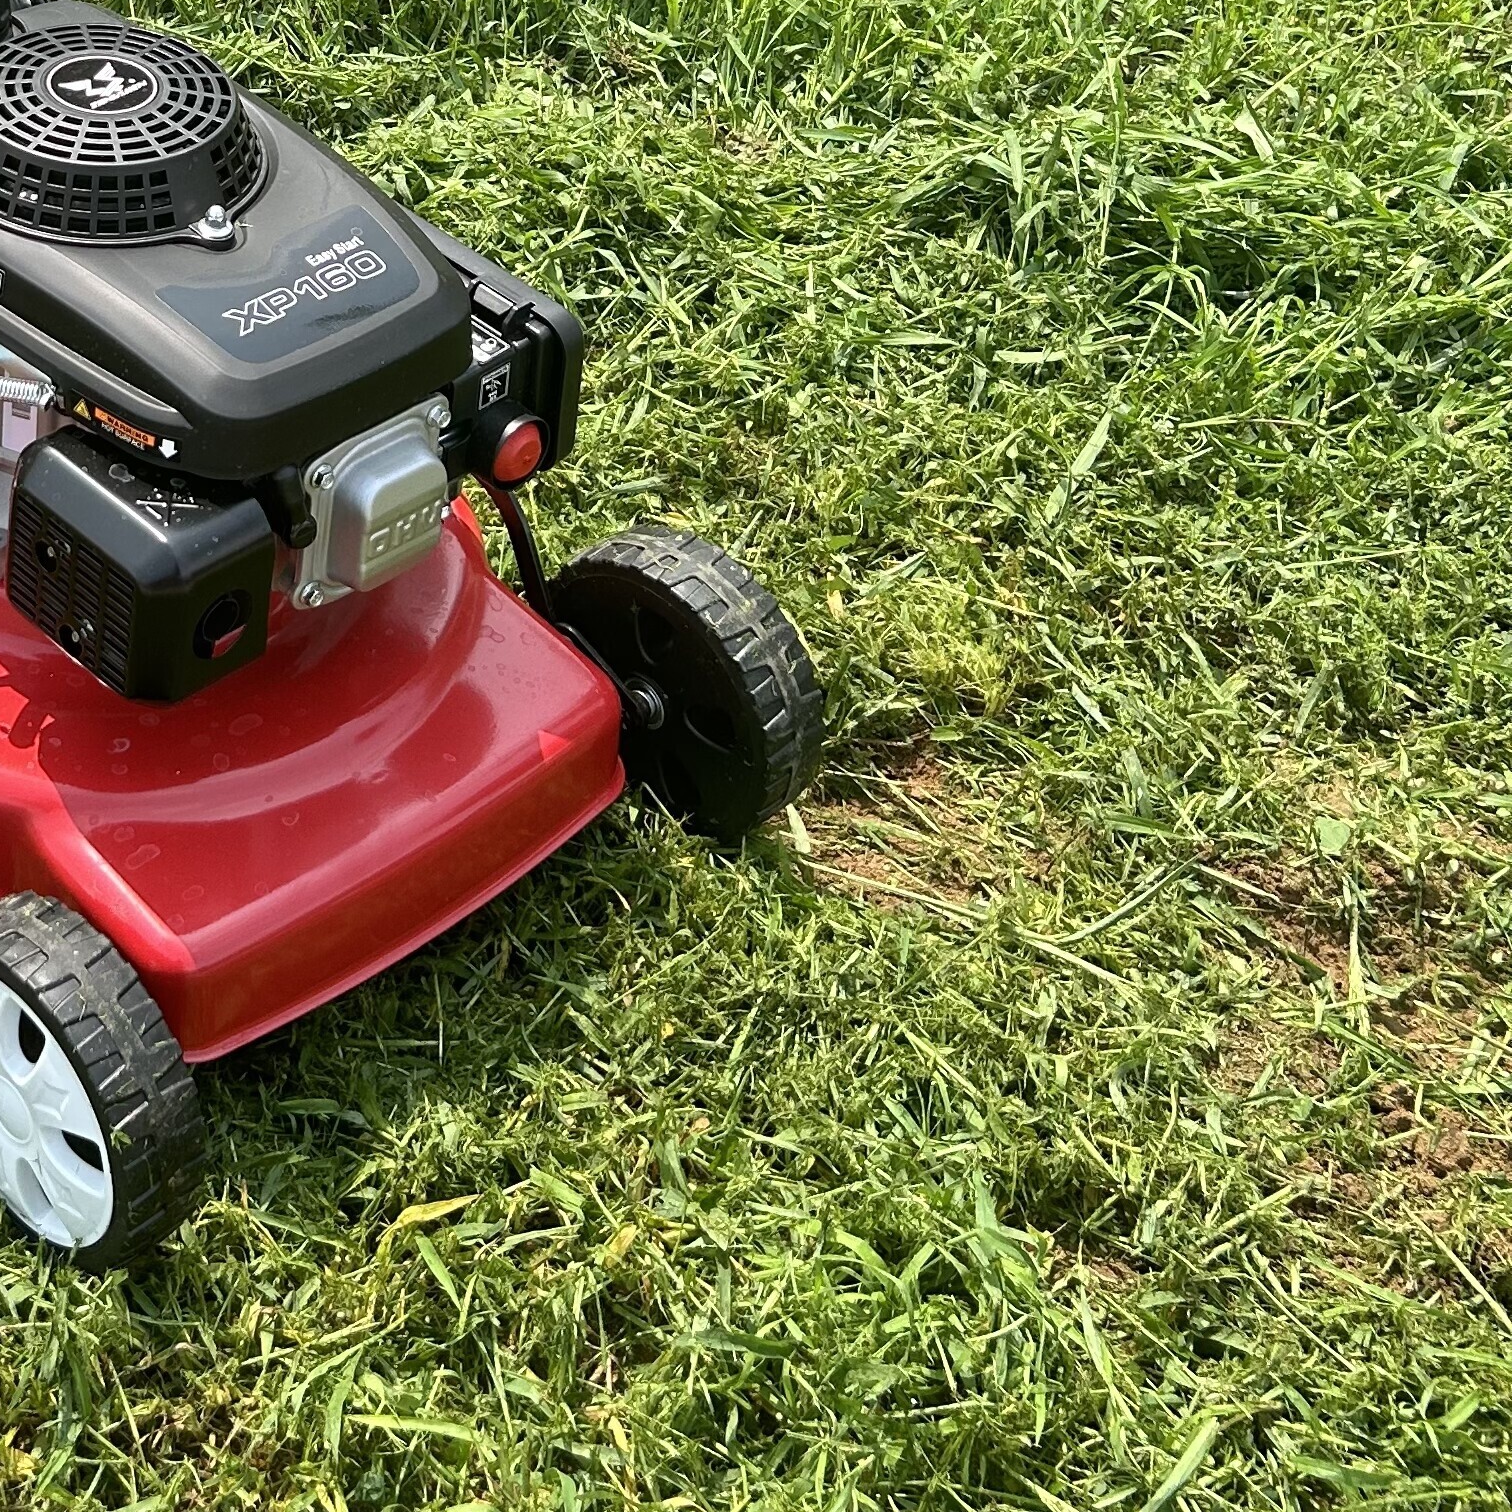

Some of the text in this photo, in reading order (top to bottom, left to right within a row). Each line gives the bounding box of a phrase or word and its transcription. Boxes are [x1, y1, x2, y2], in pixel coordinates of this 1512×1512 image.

[304, 235, 365, 268] Easy Start
[222, 249, 387, 337] XP160
[106, 416, 149, 443] WARNING
